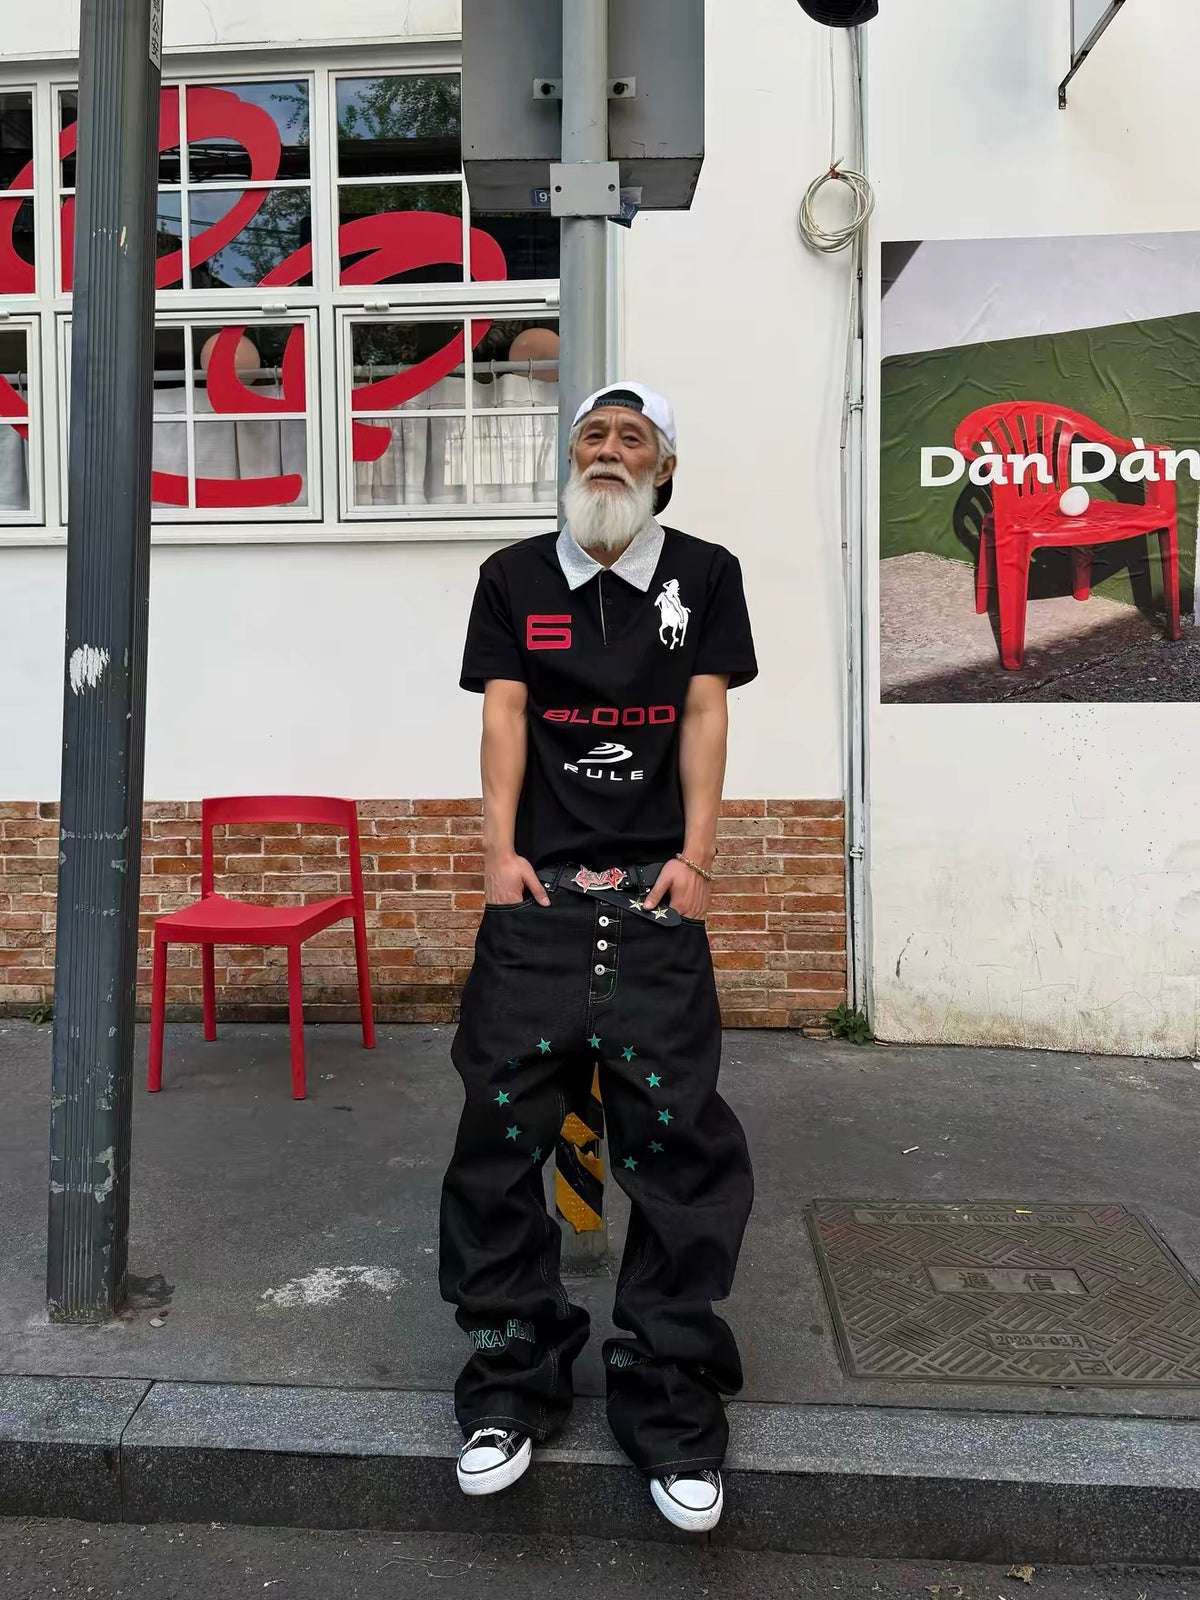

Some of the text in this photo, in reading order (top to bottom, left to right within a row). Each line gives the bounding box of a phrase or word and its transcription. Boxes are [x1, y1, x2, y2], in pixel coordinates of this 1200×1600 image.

[920, 437, 1200, 487] Dàn Dàn
[527, 614, 571, 650] 6
[543, 705, 675, 726] BLOOD
[563, 762, 644, 781] RULE
